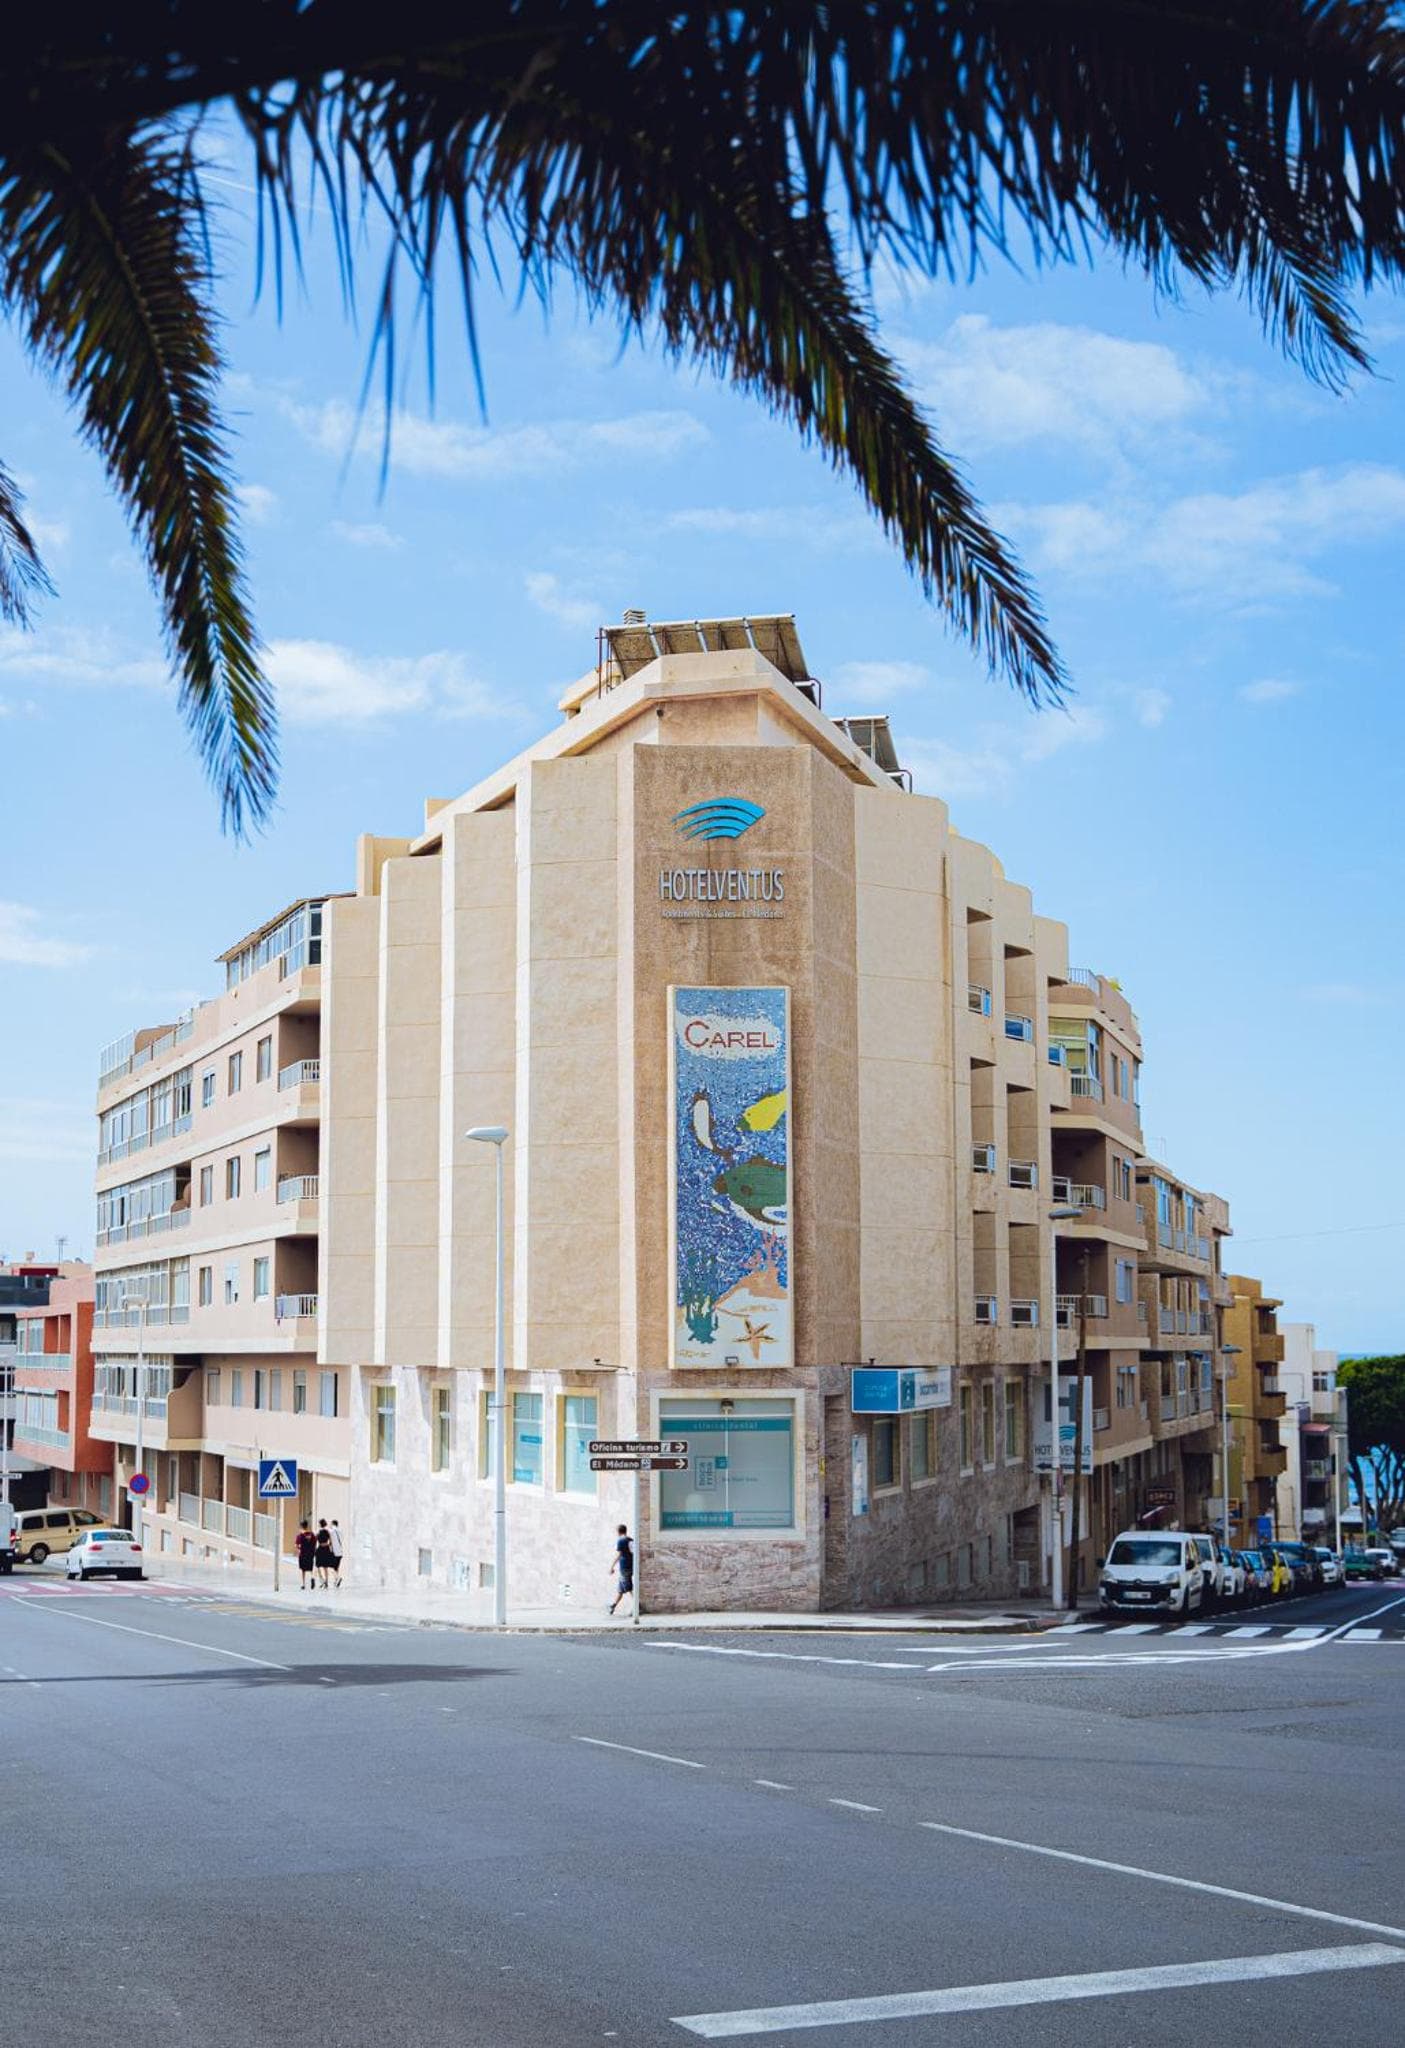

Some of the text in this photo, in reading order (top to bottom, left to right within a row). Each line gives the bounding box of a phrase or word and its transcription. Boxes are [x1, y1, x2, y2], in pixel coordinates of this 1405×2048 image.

[591, 1442, 660, 1452] Oficina turismo
[592, 1460, 640, 1469] El Médano
